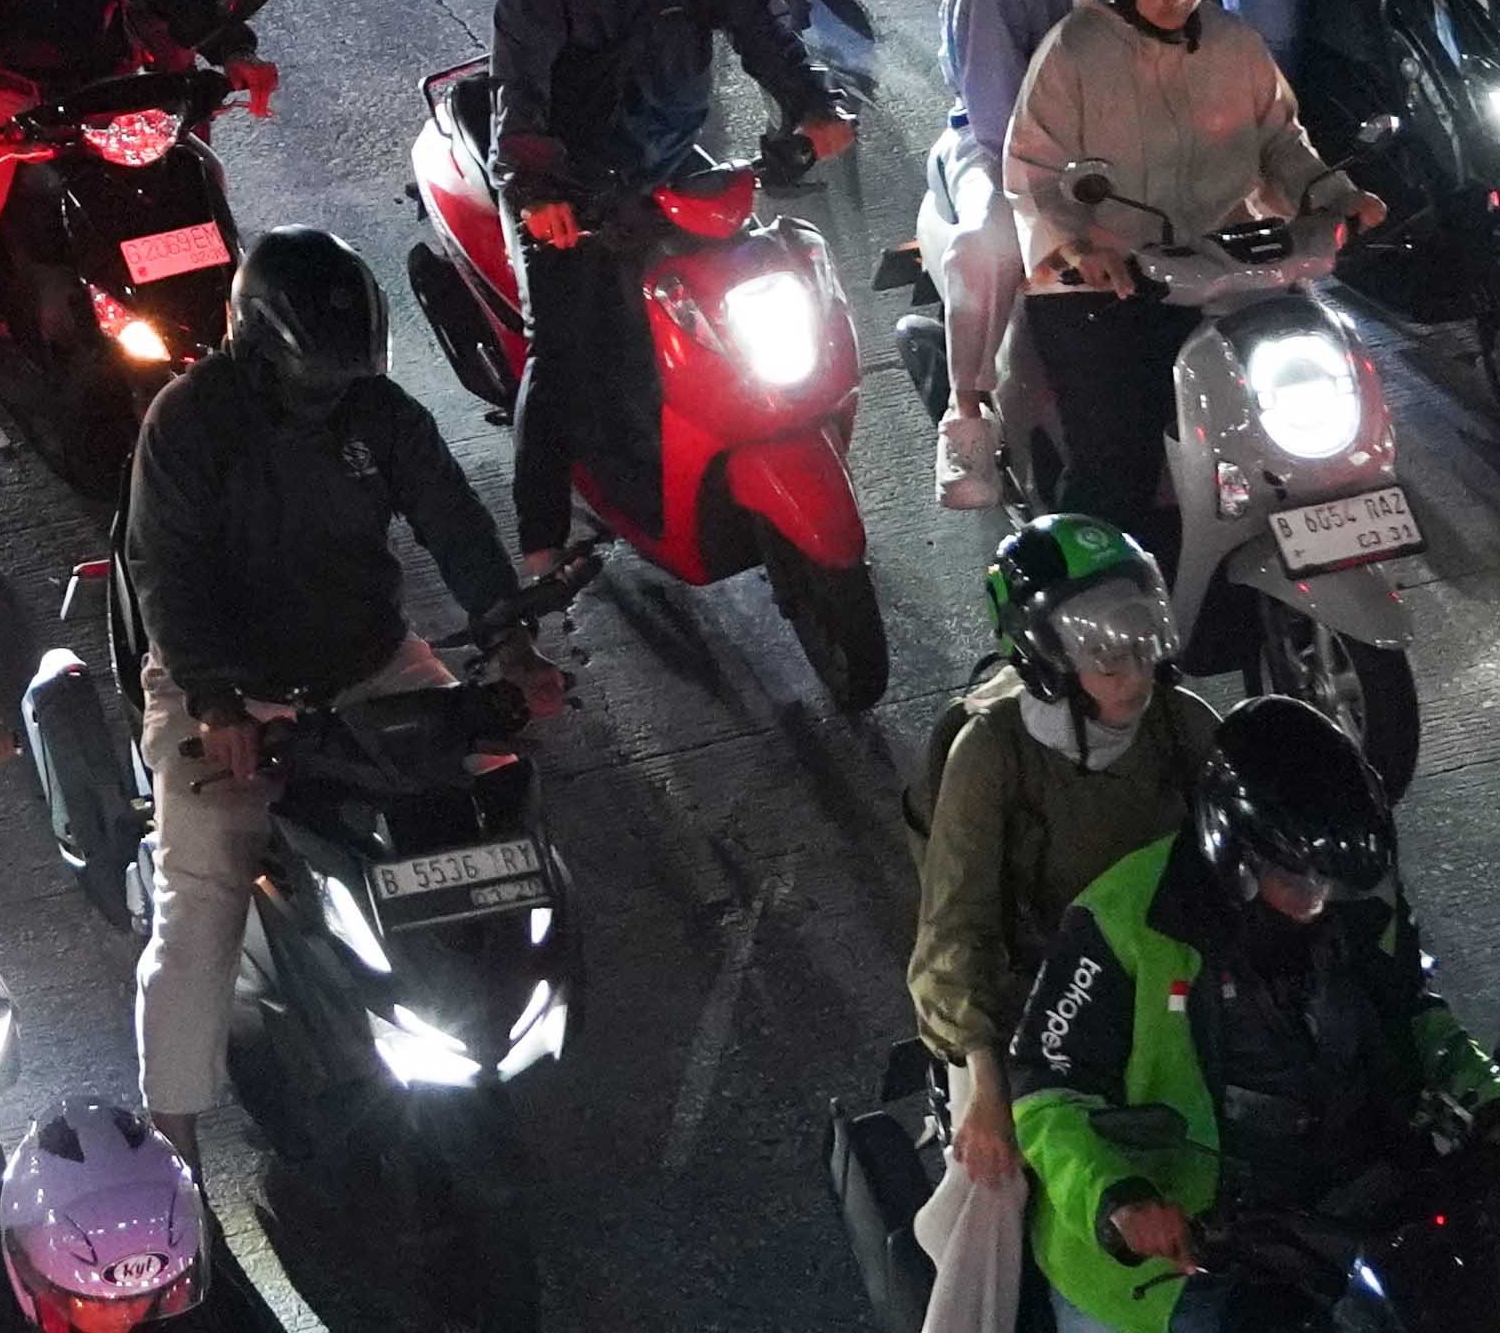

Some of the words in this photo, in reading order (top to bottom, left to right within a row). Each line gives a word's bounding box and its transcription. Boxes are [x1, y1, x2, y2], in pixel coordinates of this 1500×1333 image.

[1277, 516, 1292, 538] B
[381, 869, 397, 895] B
[412, 855, 477, 887] 5536
